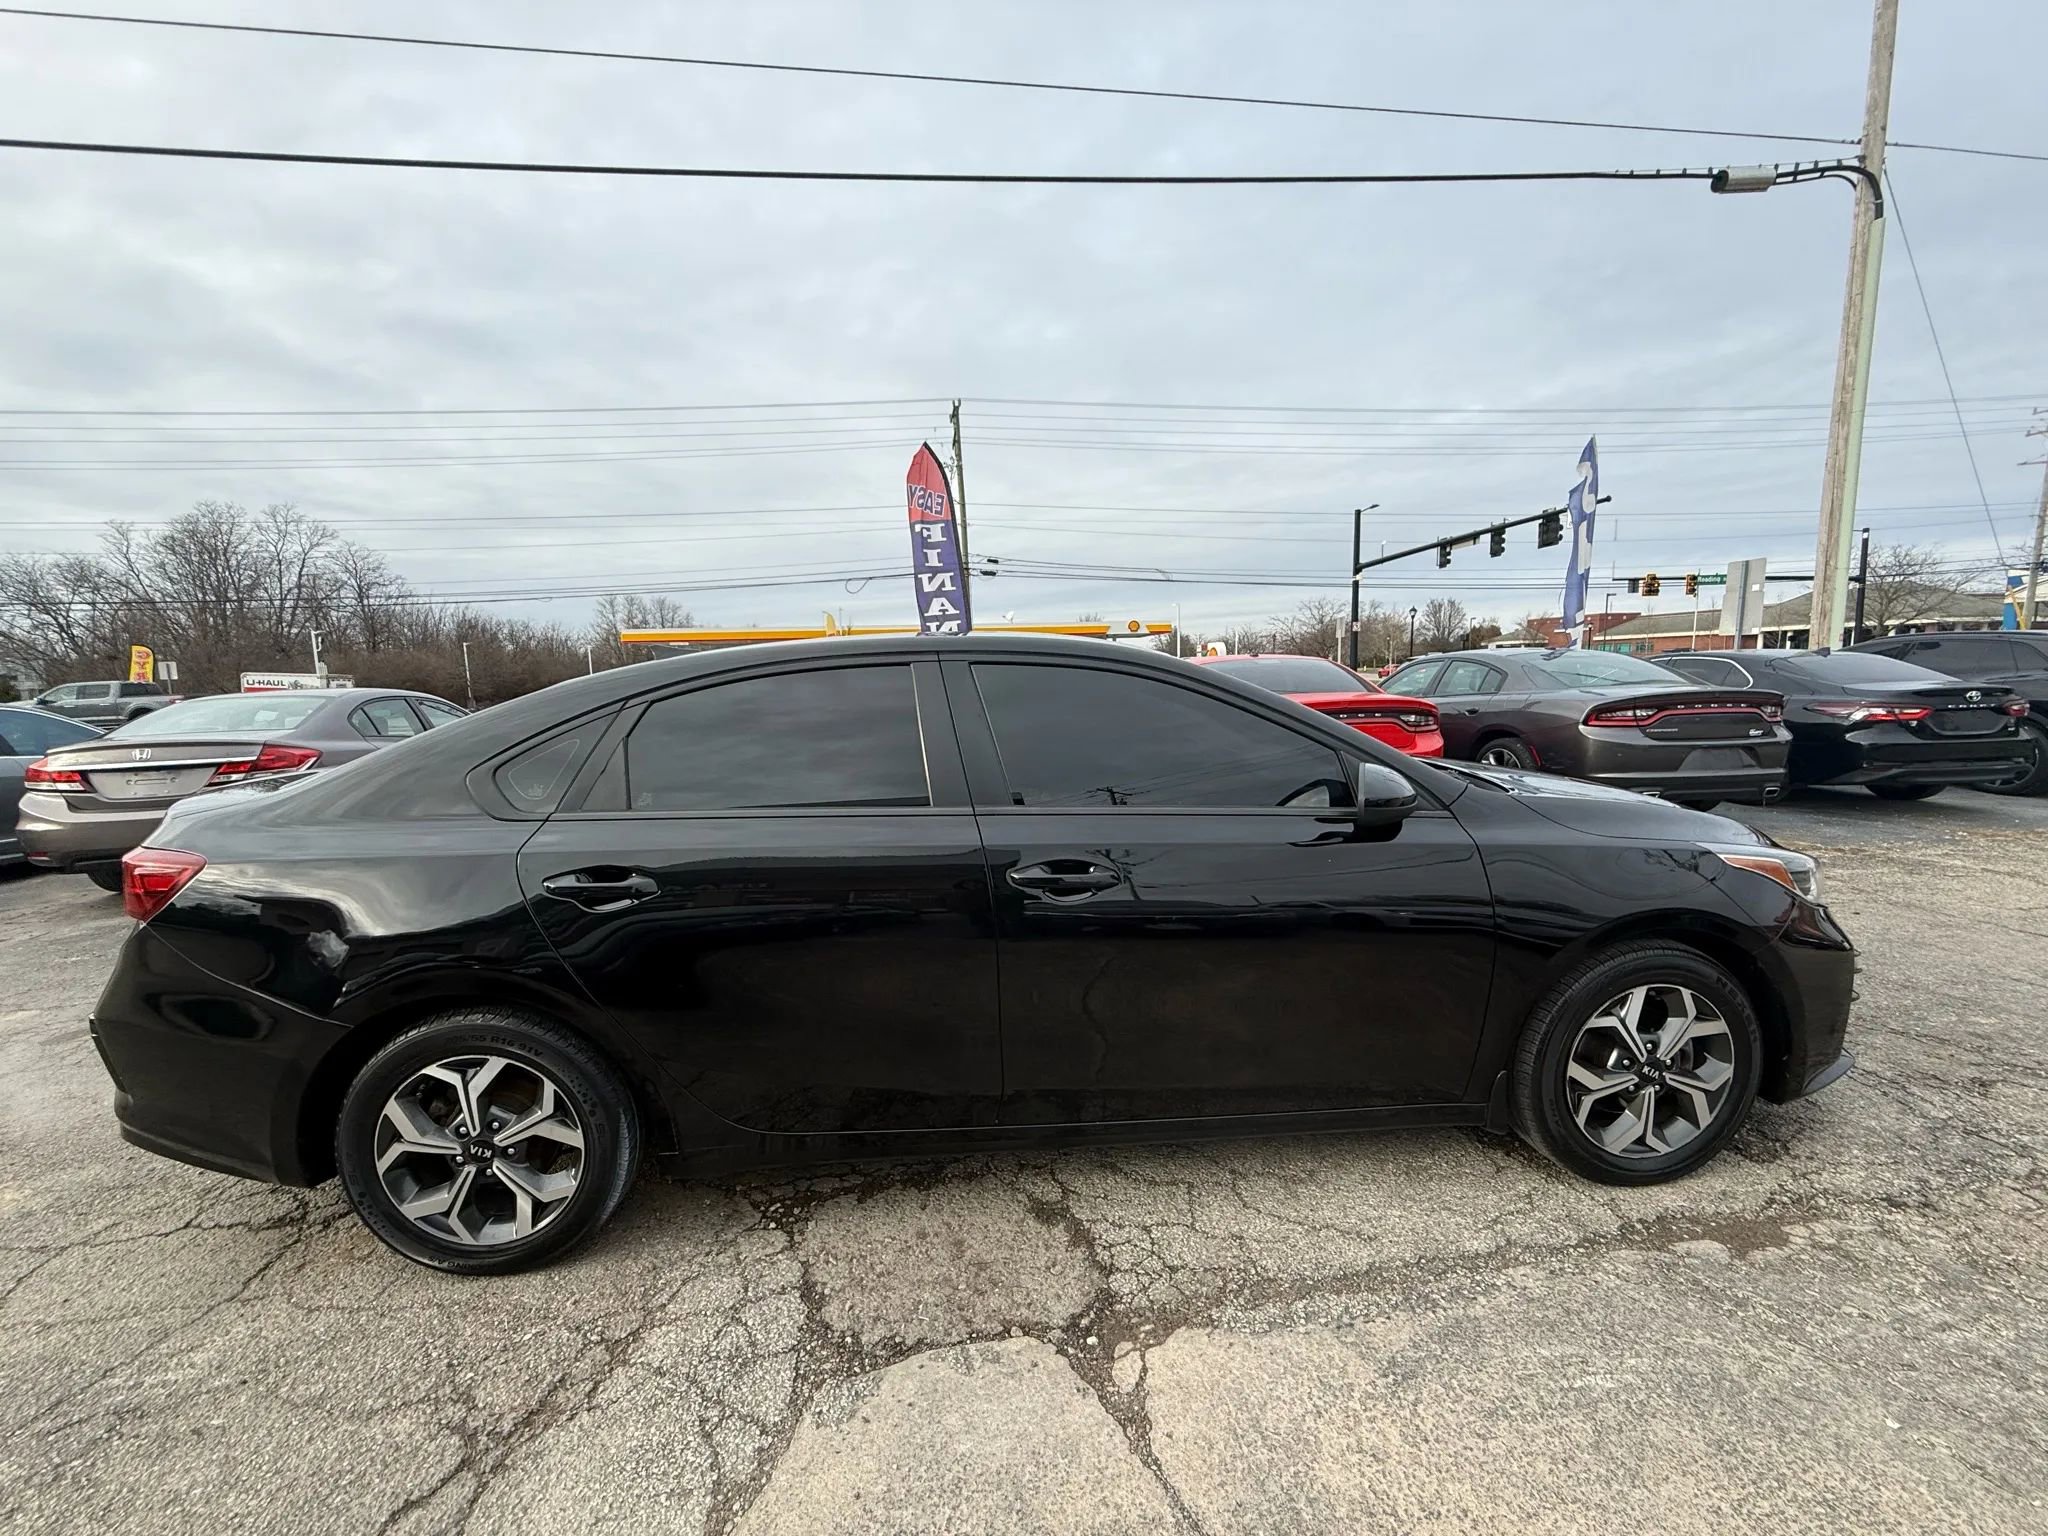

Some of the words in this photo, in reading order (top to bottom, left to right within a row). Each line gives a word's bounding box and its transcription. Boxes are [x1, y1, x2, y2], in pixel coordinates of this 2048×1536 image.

[246, 679, 286, 687] U-HAUL
[1641, 1065, 1660, 1079] KIA
[470, 1144, 492, 1158] KIA
